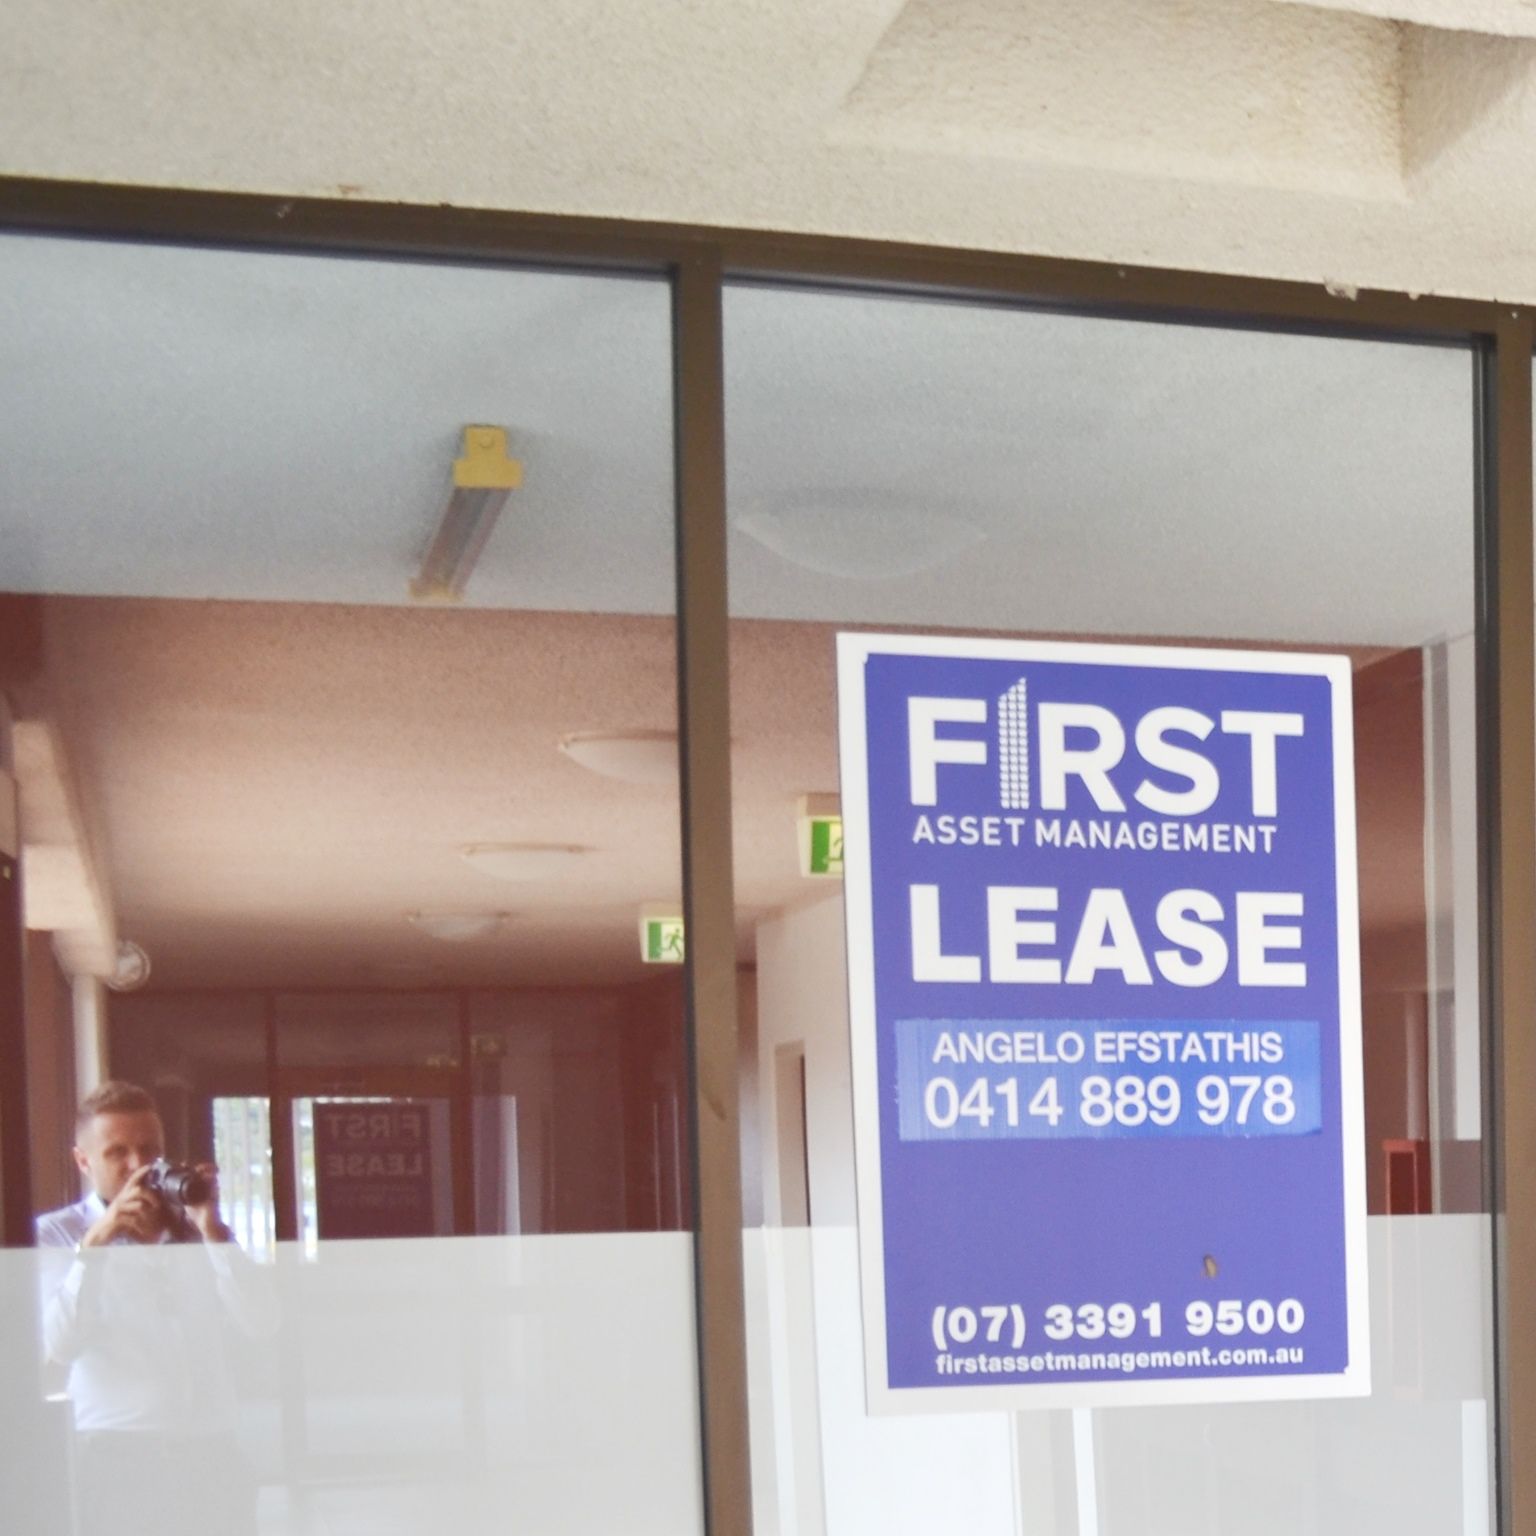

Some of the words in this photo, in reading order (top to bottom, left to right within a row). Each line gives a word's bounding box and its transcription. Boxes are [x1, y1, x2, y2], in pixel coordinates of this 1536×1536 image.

[907, 676, 1304, 817] FIRST
[912, 815, 1025, 847] ASSET
[1034, 819, 1277, 853] MANAGEMENT
[909, 883, 1307, 987] LEASE
[932, 1031, 1085, 1064] ANGELO
[1093, 1030, 1284, 1063] EFSTATHIS
[923, 1076, 1063, 1128] 0414
[1079, 1075, 1181, 1126] 889
[1196, 1074, 1296, 1125] 978
[931, 1304, 1026, 1350] (07)
[1043, 1302, 1163, 1340] 3391
[1185, 1298, 1305, 1335] 9500
[935, 1346, 1304, 1374] firstassetmanagement.com.au
